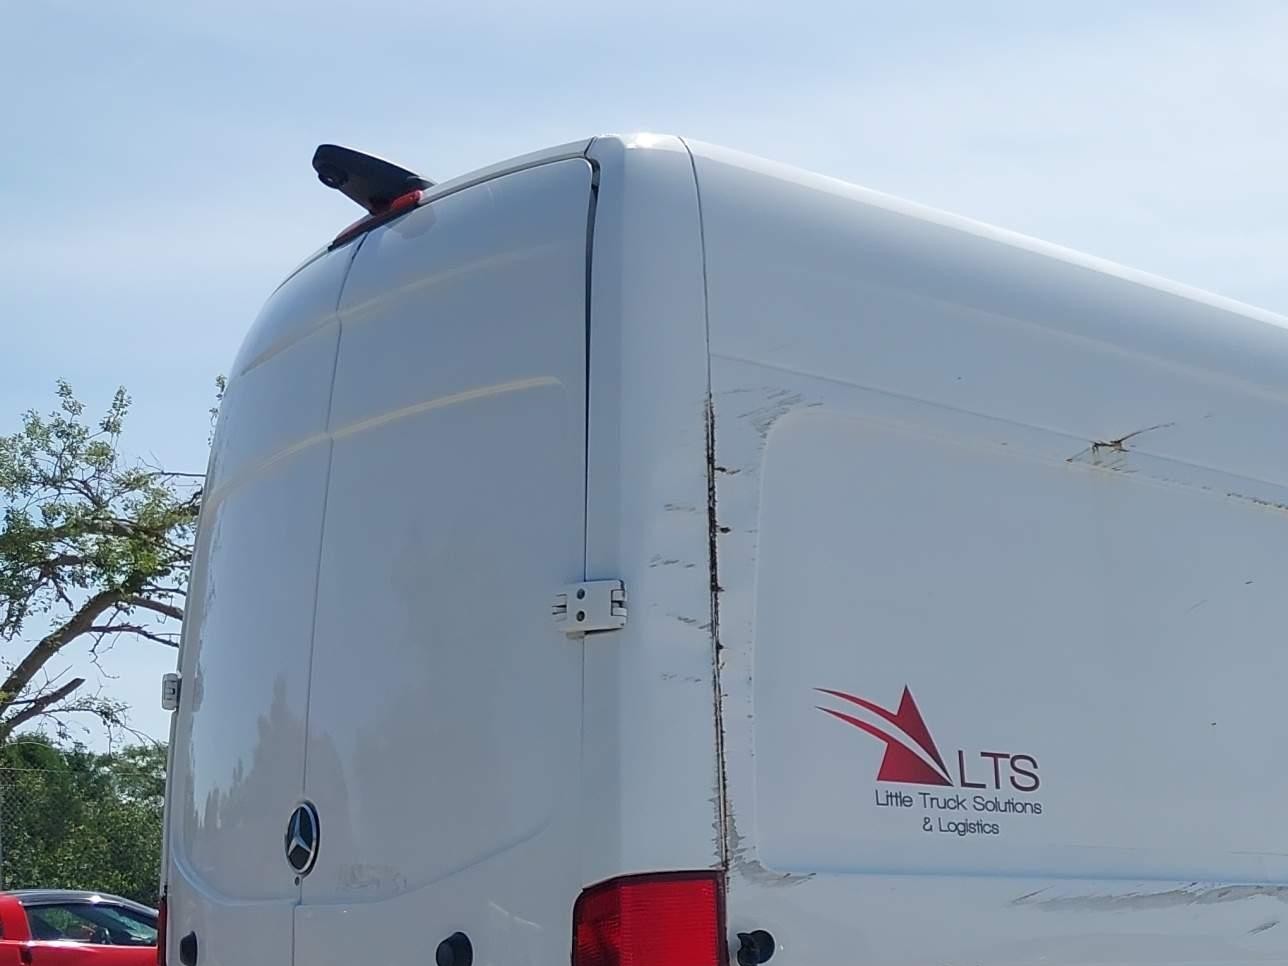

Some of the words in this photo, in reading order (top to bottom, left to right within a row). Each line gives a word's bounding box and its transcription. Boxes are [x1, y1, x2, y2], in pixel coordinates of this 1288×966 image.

[957, 749, 1040, 792] LTS
[874, 789, 913, 808] Little
[918, 791, 967, 811] Truck
[972, 795, 1042, 814] Solutions
[922, 816, 933, 832] &
[938, 817, 999, 836] Logistics
